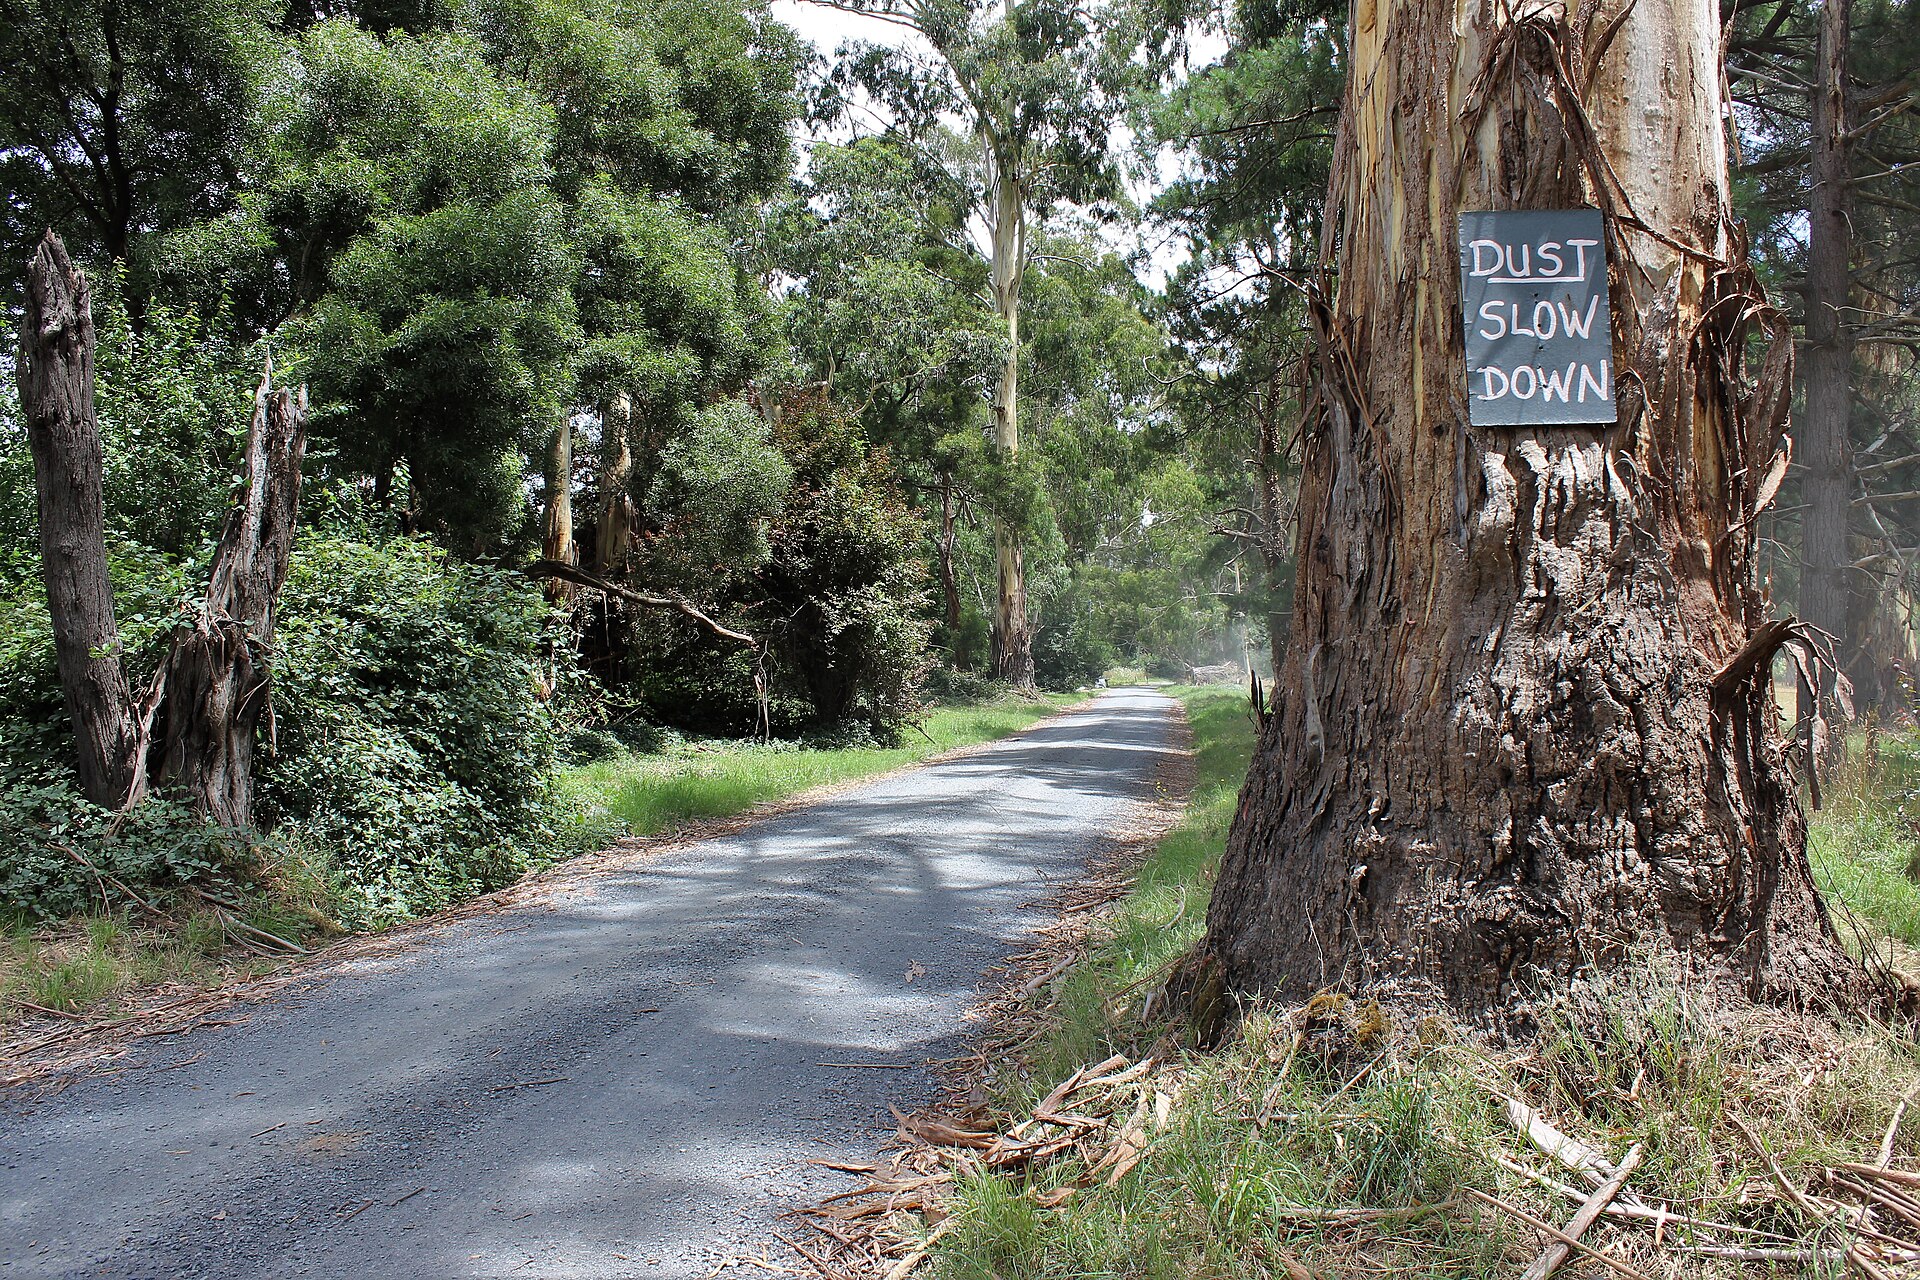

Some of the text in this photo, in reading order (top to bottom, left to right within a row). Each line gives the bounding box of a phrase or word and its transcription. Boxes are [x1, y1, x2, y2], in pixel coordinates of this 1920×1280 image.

[1468, 239, 1599, 279] DUST
[1479, 294, 1599, 341] SLOW
[1476, 359, 1609, 403] DOWN
